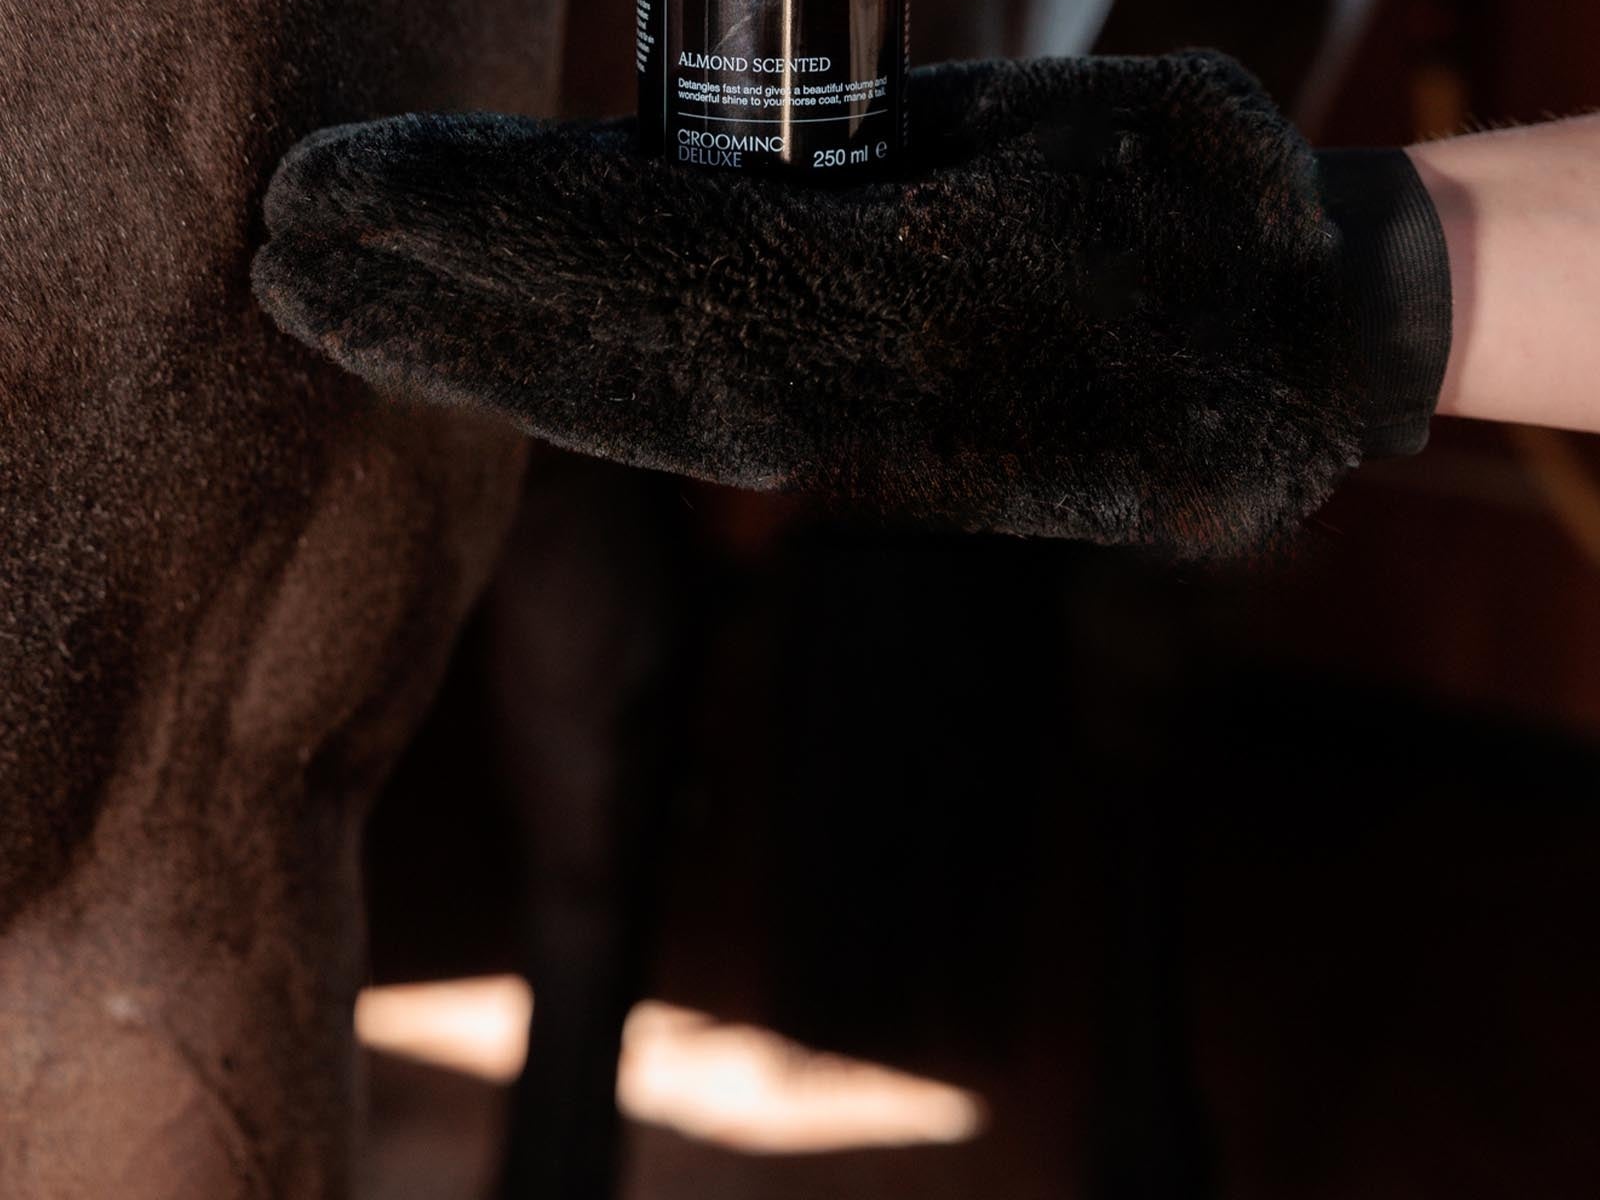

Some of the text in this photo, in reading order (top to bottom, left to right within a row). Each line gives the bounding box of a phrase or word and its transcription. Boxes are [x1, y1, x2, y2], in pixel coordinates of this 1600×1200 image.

[678, 51, 831, 73] ALMOND SCENTED
[678, 77, 720, 93] Detangles
[722, 83, 741, 94] fast
[743, 86, 762, 95] and
[803, 83, 843, 95] beautiful
[845, 80, 873, 92] volume
[874, 75, 887, 87] and
[678, 90, 720, 103] wonderful
[721, 95, 748, 105] shine
[751, 98, 761, 106] to
[763, 98, 786, 108] your
[788, 98, 817, 106] horse
[818, 93, 842, 105] coat,
[844, 92, 867, 103] mane
[868, 89, 874, 99] &
[678, 145, 742, 168] DELUXE
[813, 149, 846, 167] 250
[850, 145, 868, 164] ml
